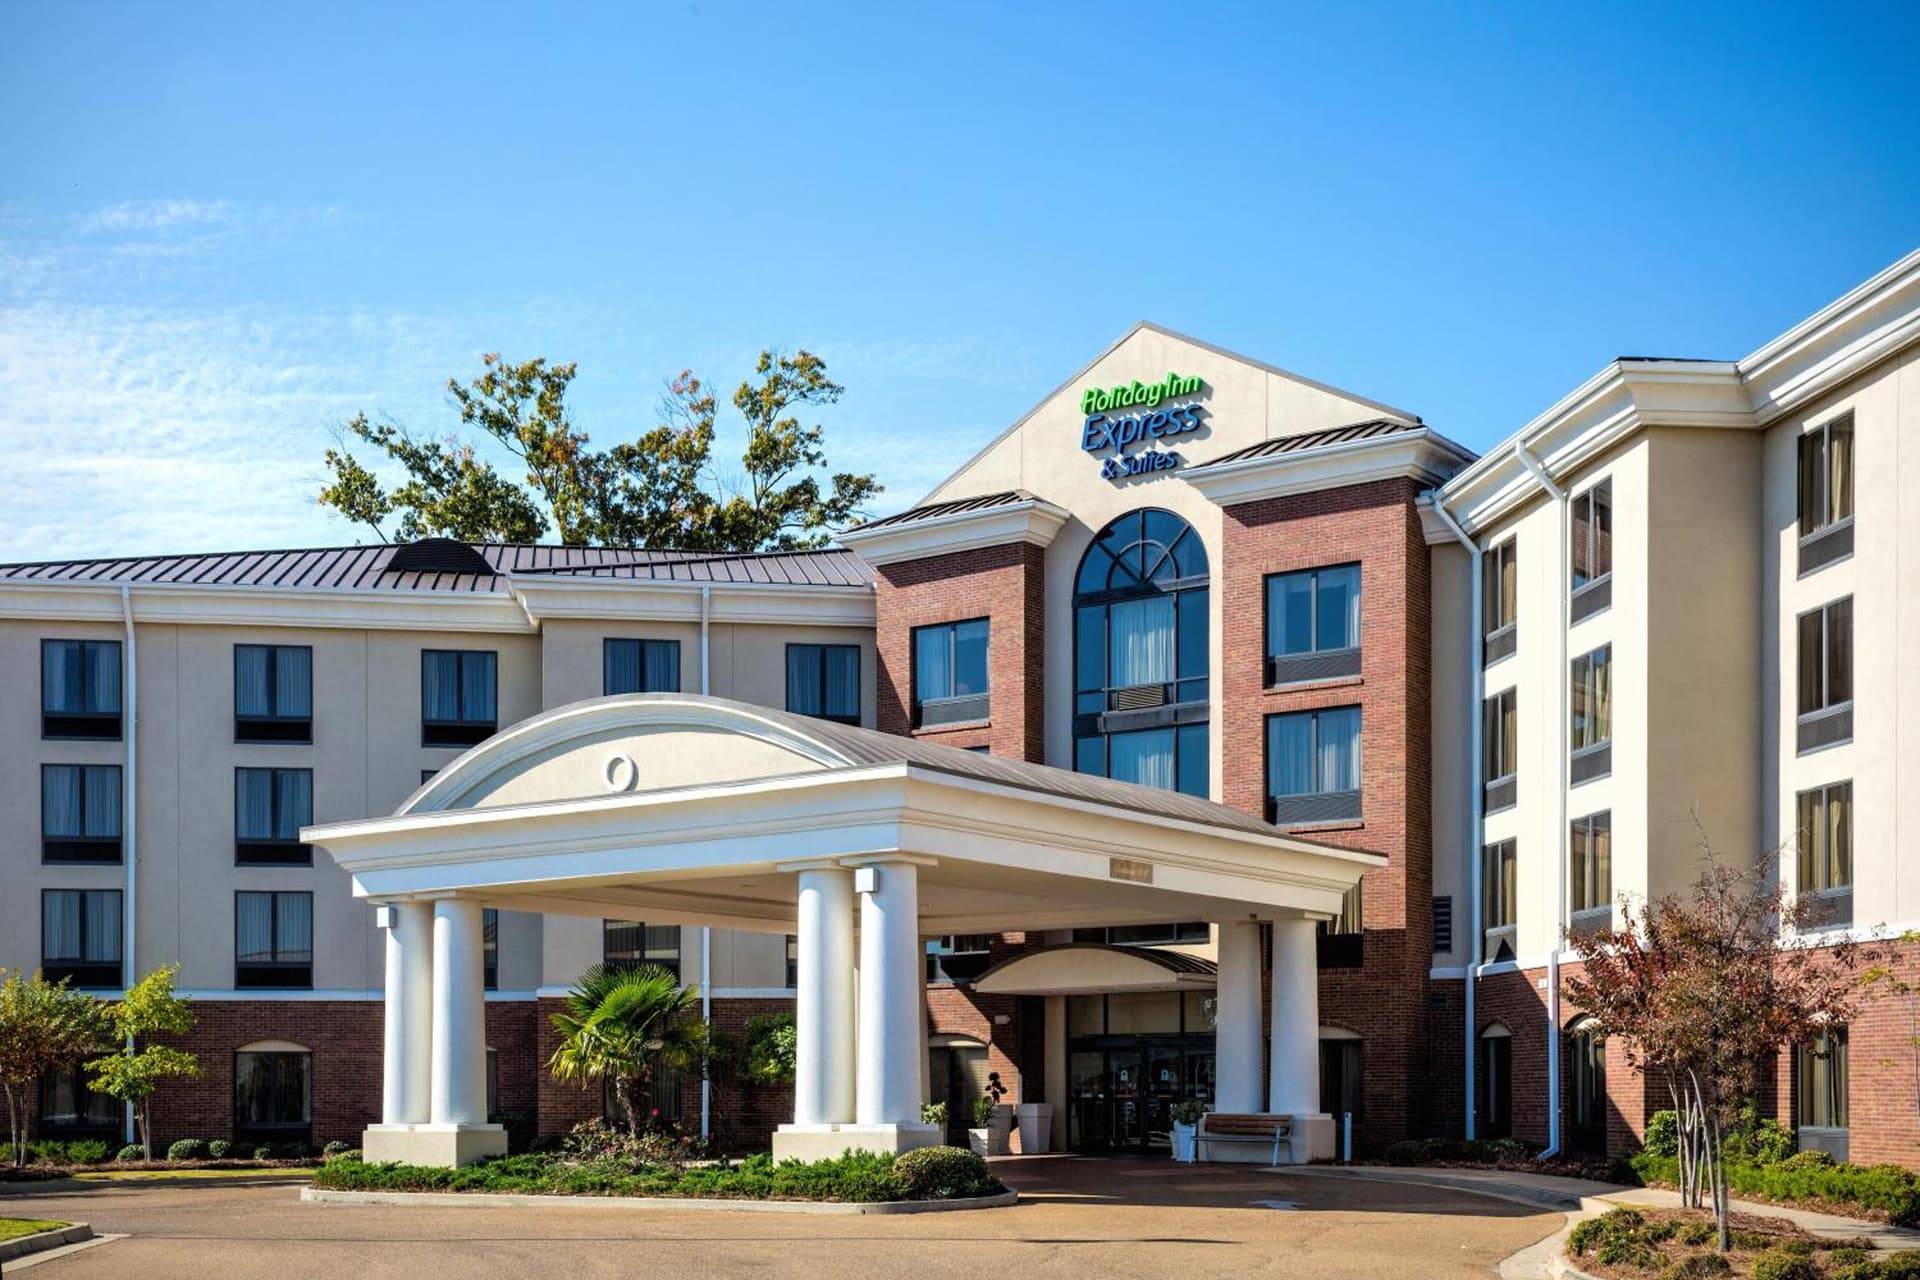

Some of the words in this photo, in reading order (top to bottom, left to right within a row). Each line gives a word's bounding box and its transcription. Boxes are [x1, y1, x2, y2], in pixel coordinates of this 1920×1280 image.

[1081, 380, 1162, 414] Holiday
[1165, 372, 1201, 397] Inn
[1081, 404, 1201, 455] Express
[1101, 457, 1117, 480] &
[1119, 450, 1178, 478] Suites
